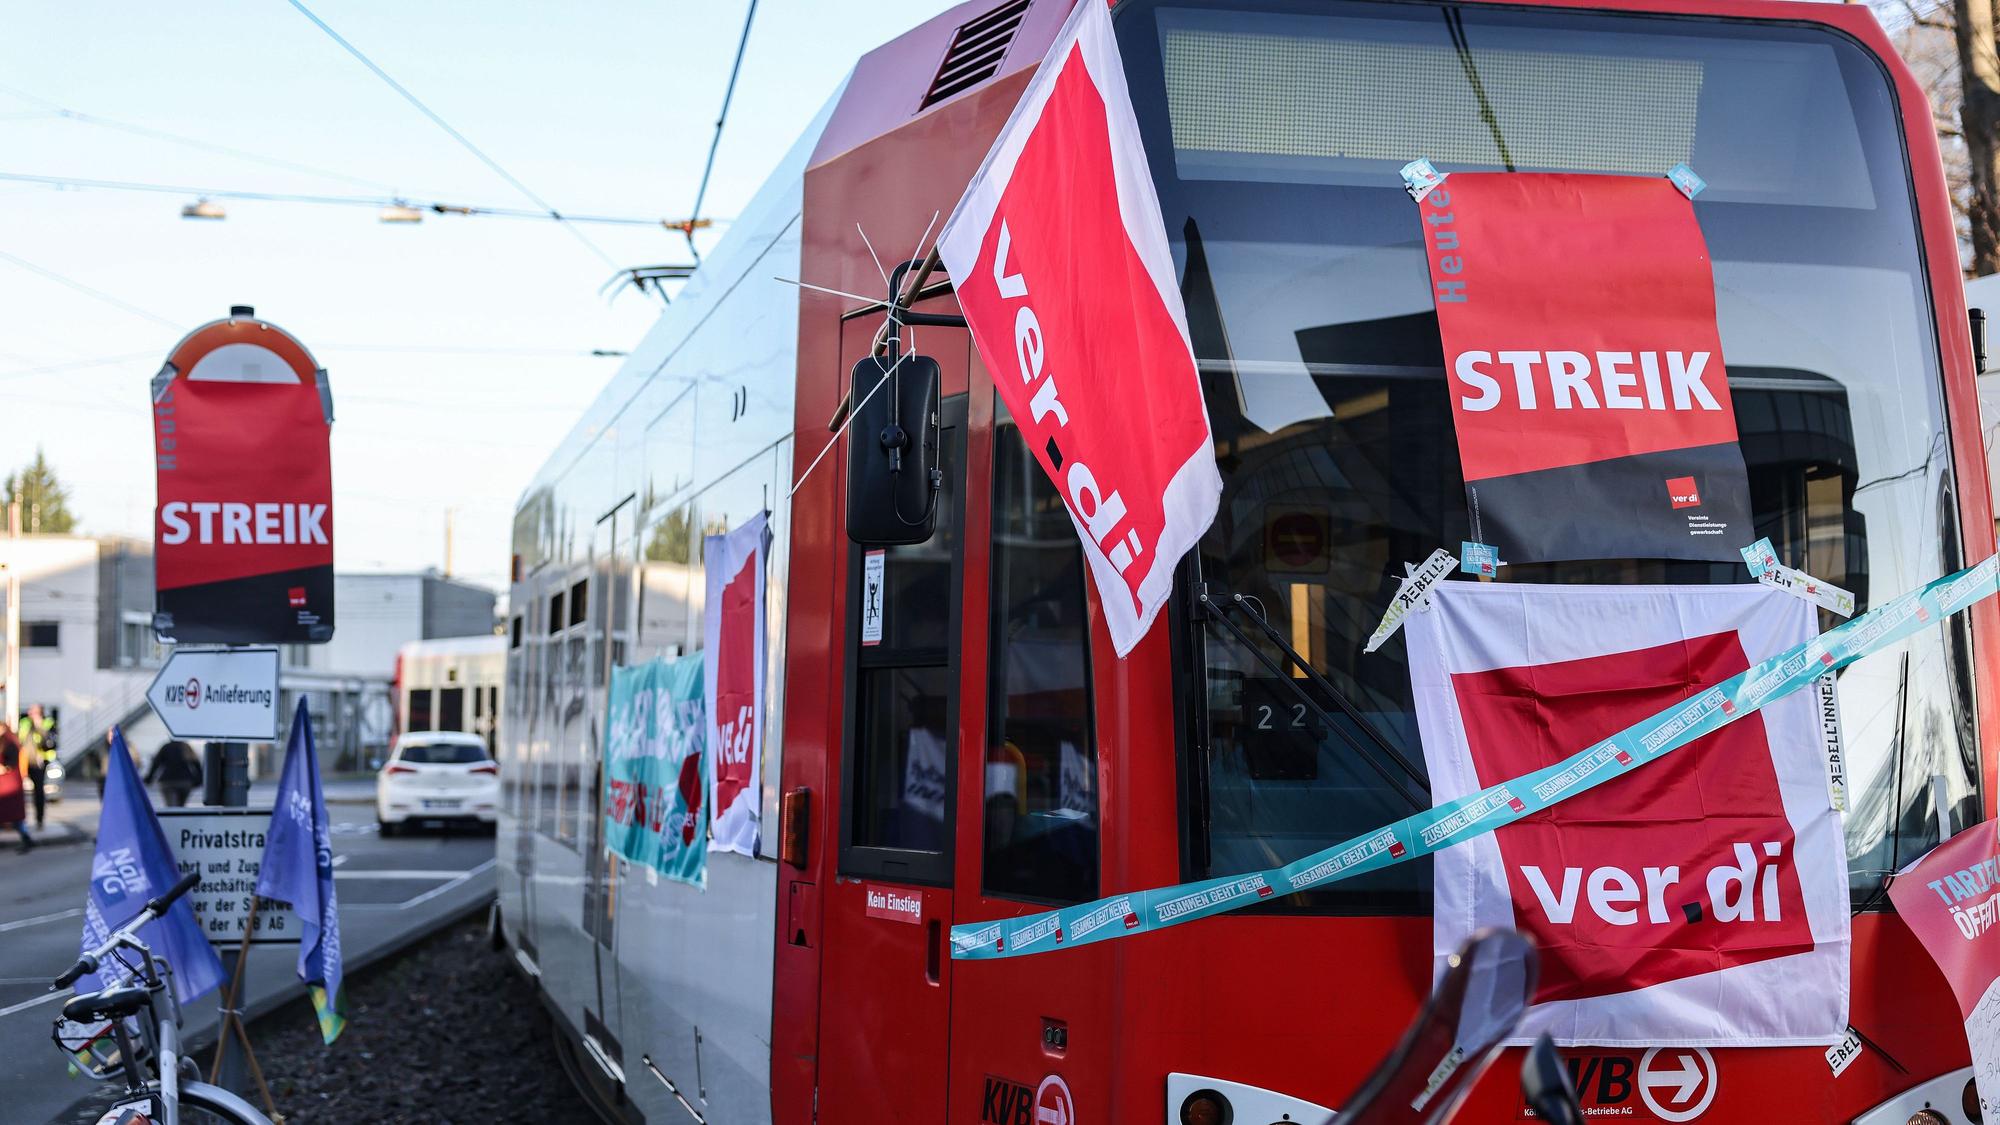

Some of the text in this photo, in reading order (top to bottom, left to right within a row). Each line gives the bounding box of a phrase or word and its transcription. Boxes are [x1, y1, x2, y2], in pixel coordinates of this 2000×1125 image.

[993, 218, 1143, 577] ver.di
[1455, 350, 1722, 412] STREIK
[161, 502, 329, 545] STREIK
[1784, 658, 1806, 675] GEHT
[165, 684, 271, 708] KVB Anlieferung
[1642, 690, 1726, 751] ZUSAMMEN GEHT MEHR
[1533, 743, 1620, 799] ZUSAMMEN GEHT MEHR
[1422, 789, 1513, 844] ZUSAMMEN GEHT MEHR
[181, 829, 265, 848] Privatstra
[1290, 831, 1397, 888] ZUSAMMEN GEHT MEHR
[208, 860, 230, 873] und
[238, 860, 259, 876] Zug
[1519, 841, 1783, 925] ver.di
[215, 899, 235, 912] der
[868, 891, 921, 918] Kein Einstieg
[1156, 876, 1266, 919] ZUSAMMEN GEHT MEHR
[210, 917, 230, 931] der
[237, 917, 262, 931] KB
[268, 917, 284, 931] AG
[1010, 916, 1060, 948] ZUSAMMEN GEHT MEHR
[1071, 900, 1132, 939] ZUSAMMEN GEHT MEHR
[982, 1078, 1034, 1125] KVB
[1565, 1056, 1634, 1104] VB
[1621, 1107, 1633, 1115] AG
